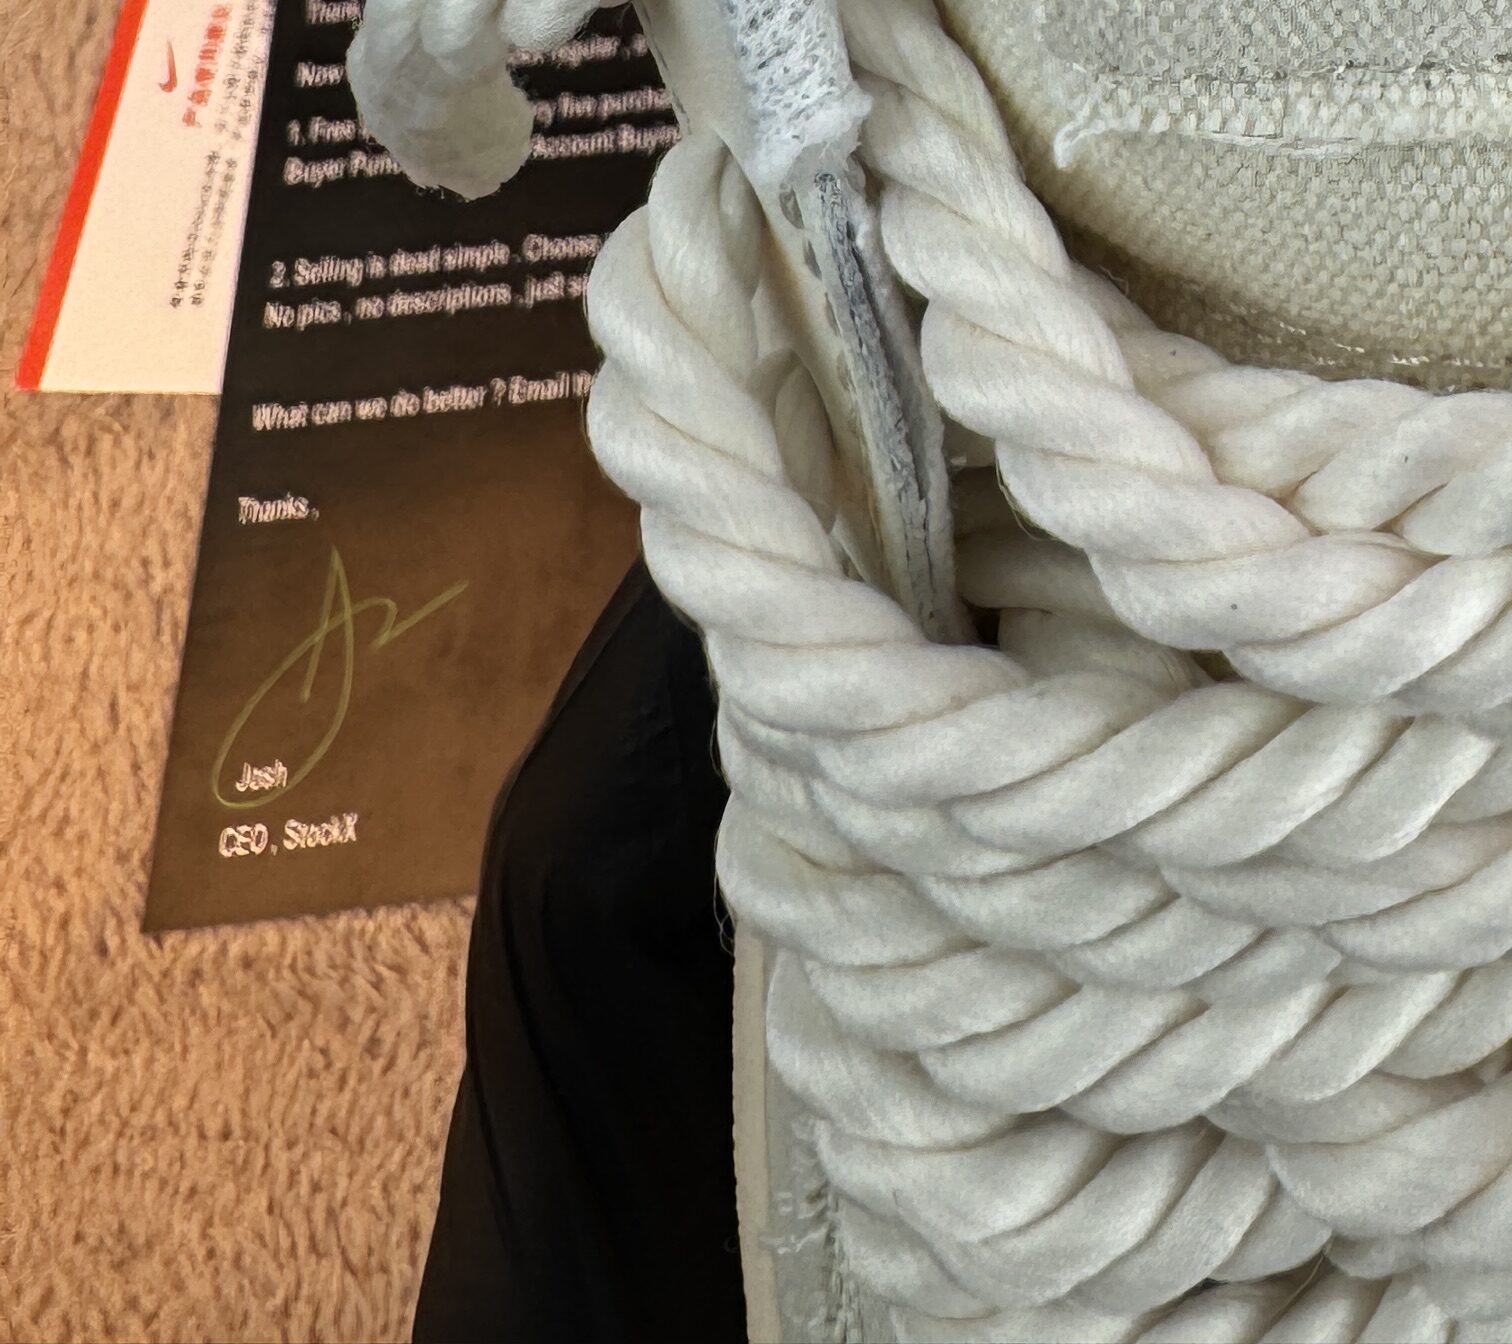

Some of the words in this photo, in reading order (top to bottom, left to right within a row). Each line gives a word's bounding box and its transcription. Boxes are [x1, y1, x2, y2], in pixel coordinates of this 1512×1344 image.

[252, 402, 309, 432] What
[311, 401, 352, 426] can
[355, 397, 388, 421] we
[235, 759, 288, 792] Josh
[283, 812, 358, 850] StockX
